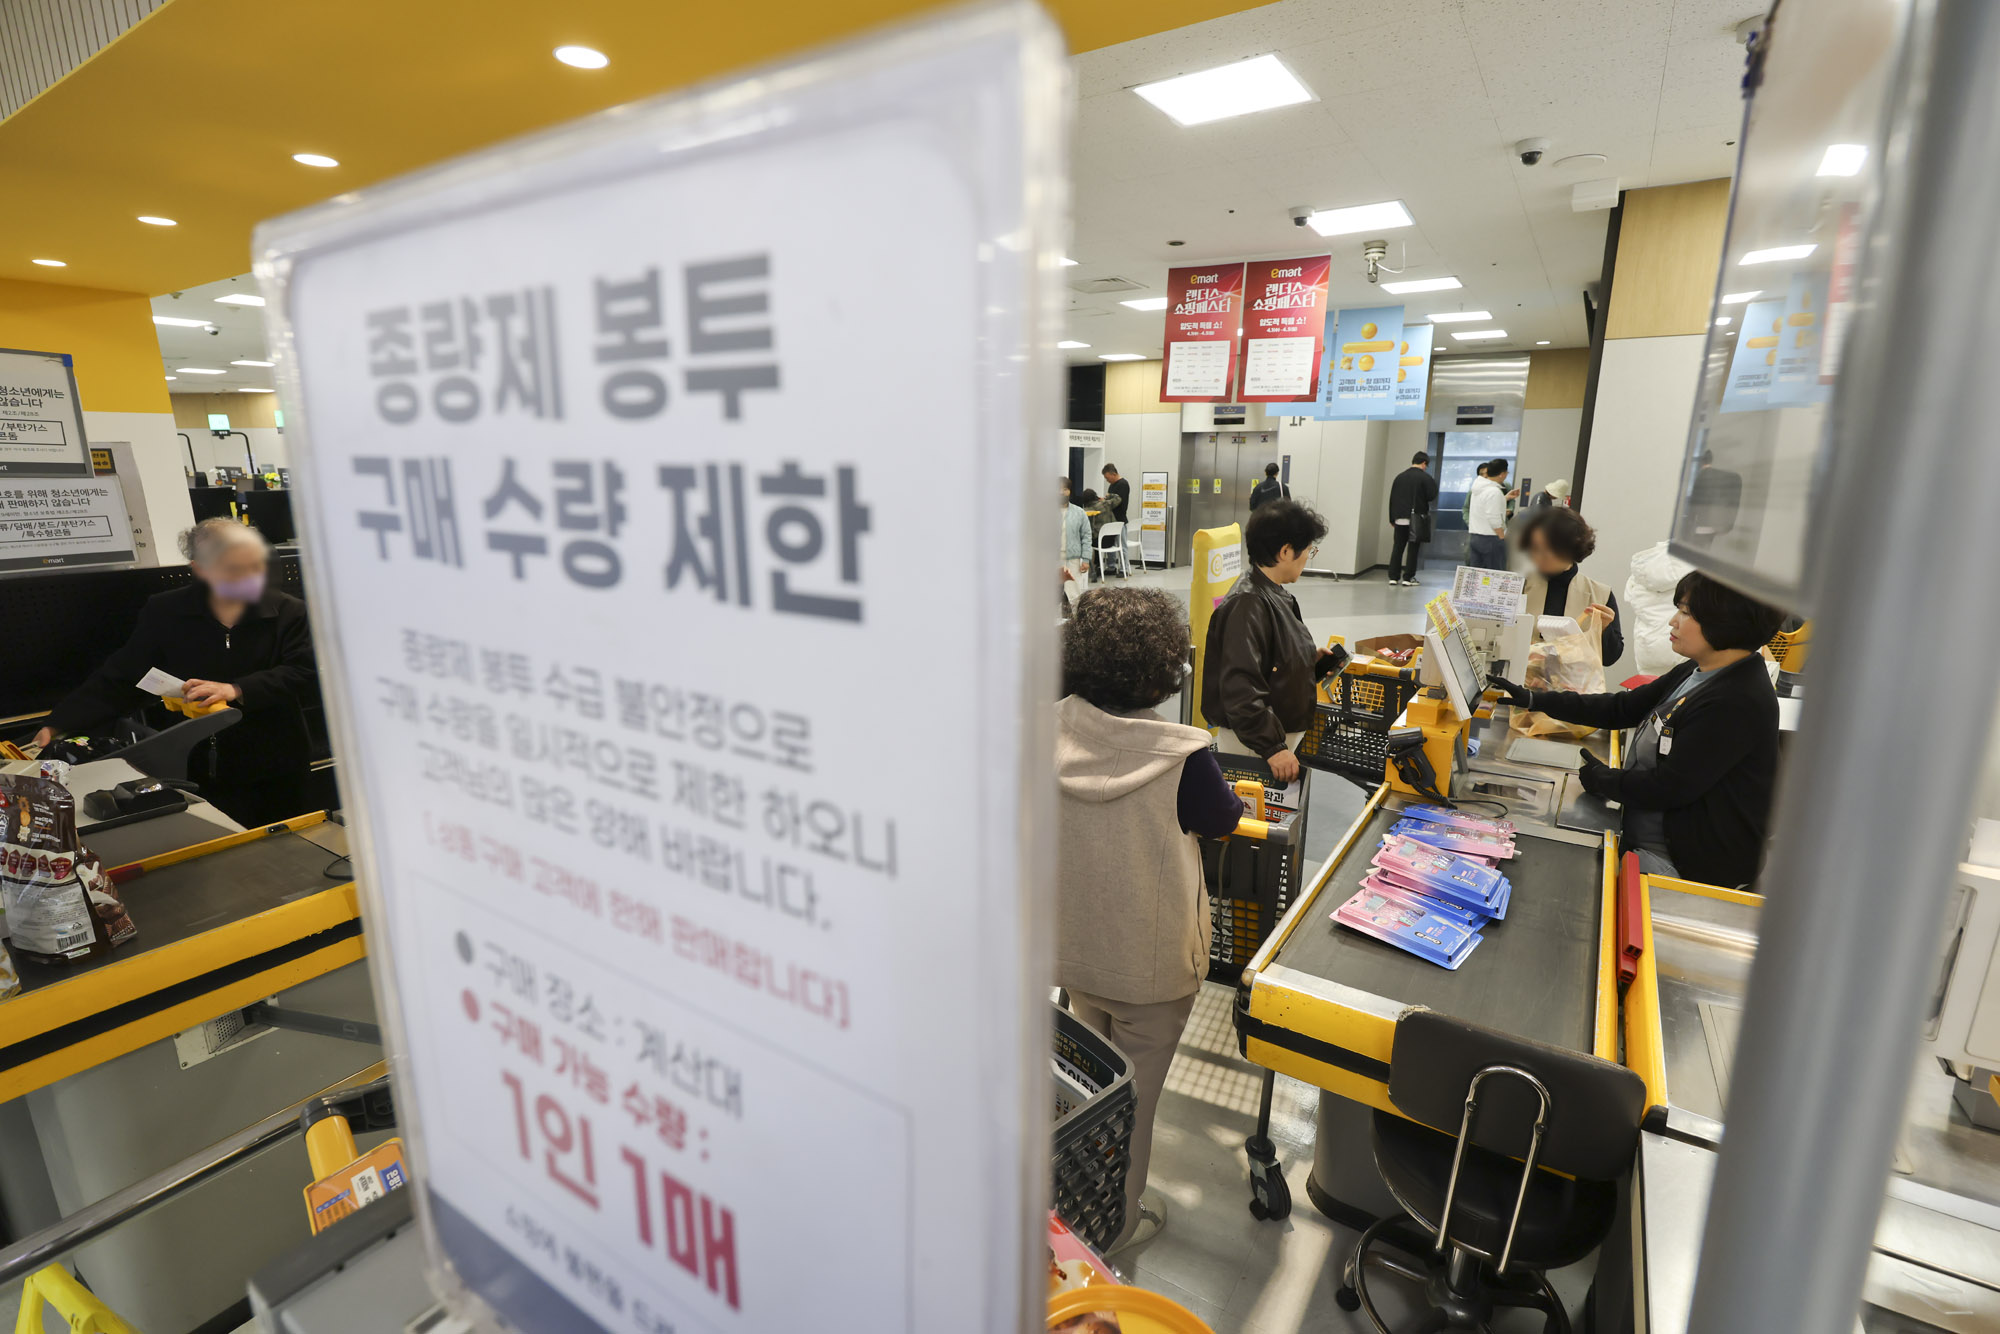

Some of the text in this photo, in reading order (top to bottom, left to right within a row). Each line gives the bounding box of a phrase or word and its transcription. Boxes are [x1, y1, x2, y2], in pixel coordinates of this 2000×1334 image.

[1174, 297, 1232, 315] 쇼핑페스타
[1186, 288, 1222, 303] 랜더스
[1190, 273, 1218, 285] emart
[1252, 291, 1316, 311] 쇼핑페스타
[1266, 282, 1306, 298] 랜더스
[1270, 266, 1302, 278] emart
[365, 252, 781, 426] 종량제 봉투
[7, 497, 91, 509] 판매하지 않습니다
[27, 489, 48, 499] 위해
[50, 487, 109, 499] 청소년에게는
[43, 557, 65, 565] emart
[351, 455, 872, 624] 구매 수량 제한
[479, 645, 537, 702] 봉투
[545, 659, 606, 722] 수급
[614, 674, 815, 776] 불안정으로
[504, 710, 661, 801] 일시적으로
[670, 757, 749, 832] 제한
[761, 784, 900, 884] 하오니
[586, 796, 654, 865] 양해
[660, 823, 833, 932] 바랍니다.
[669, 911, 851, 1030] 판매합니다]
[484, 940, 539, 1007] 구매
[544, 971, 607, 1043] 장소
[632, 1018, 745, 1121] 계산대
[490, 1000, 545, 1068] 구매
[550, 1035, 610, 1106] 가능
[620, 1081, 688, 1153] 수량
[501, 1068, 742, 1314] 1인 1매
